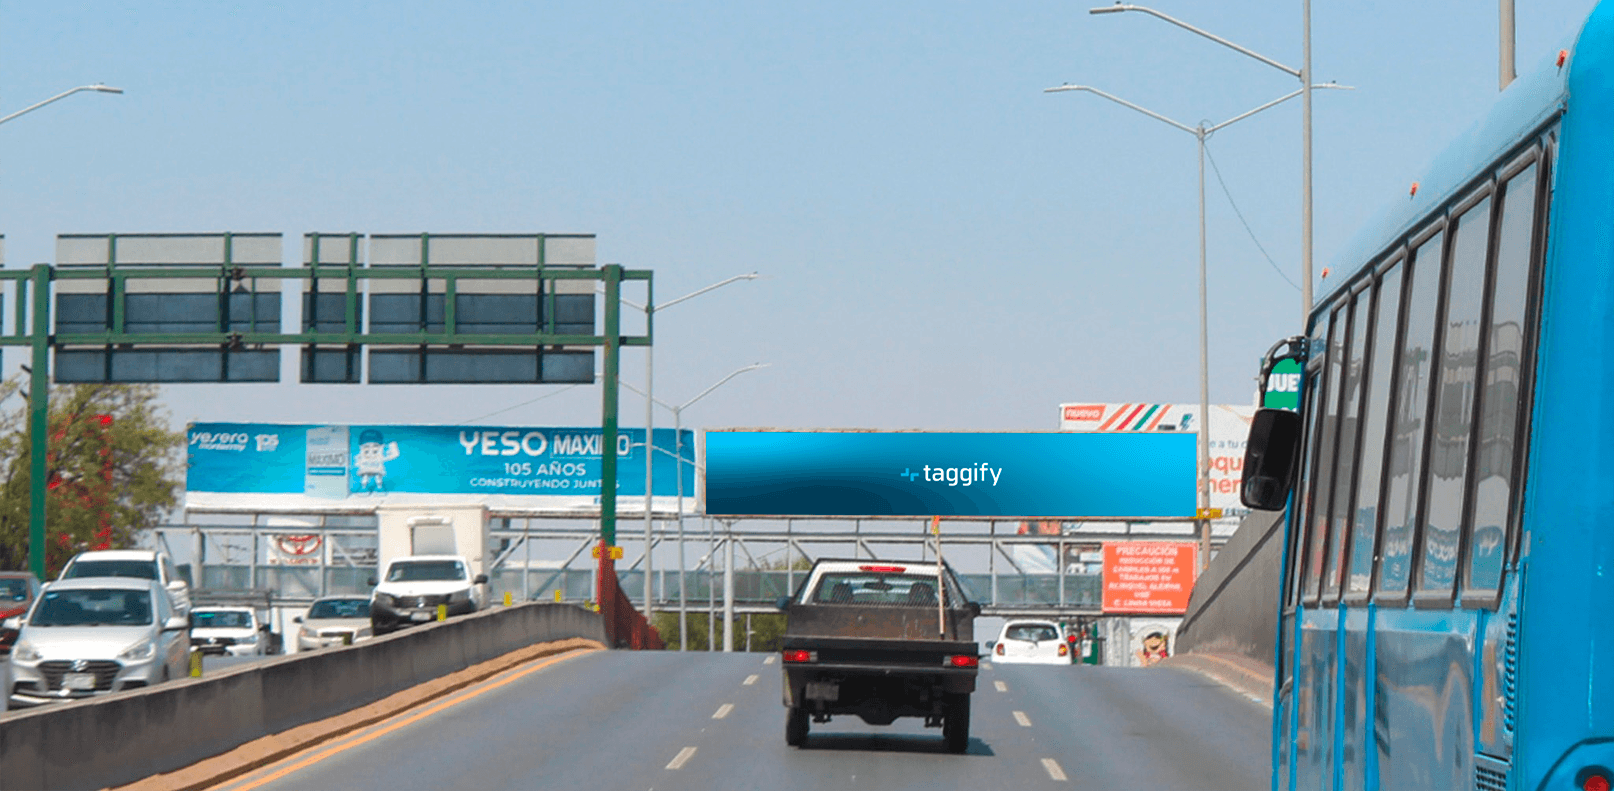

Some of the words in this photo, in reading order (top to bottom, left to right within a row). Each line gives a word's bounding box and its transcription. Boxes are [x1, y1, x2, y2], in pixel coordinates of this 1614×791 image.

[1267, 373, 1300, 392] JUE
[459, 431, 548, 456] YESO
[554, 434, 630, 456] MAXIO
[504, 462, 532, 476] 105
[536, 461, 586, 476] AÑOS
[923, 462, 1002, 487] taggify
[470, 478, 570, 489] CONSTRUYENDO
